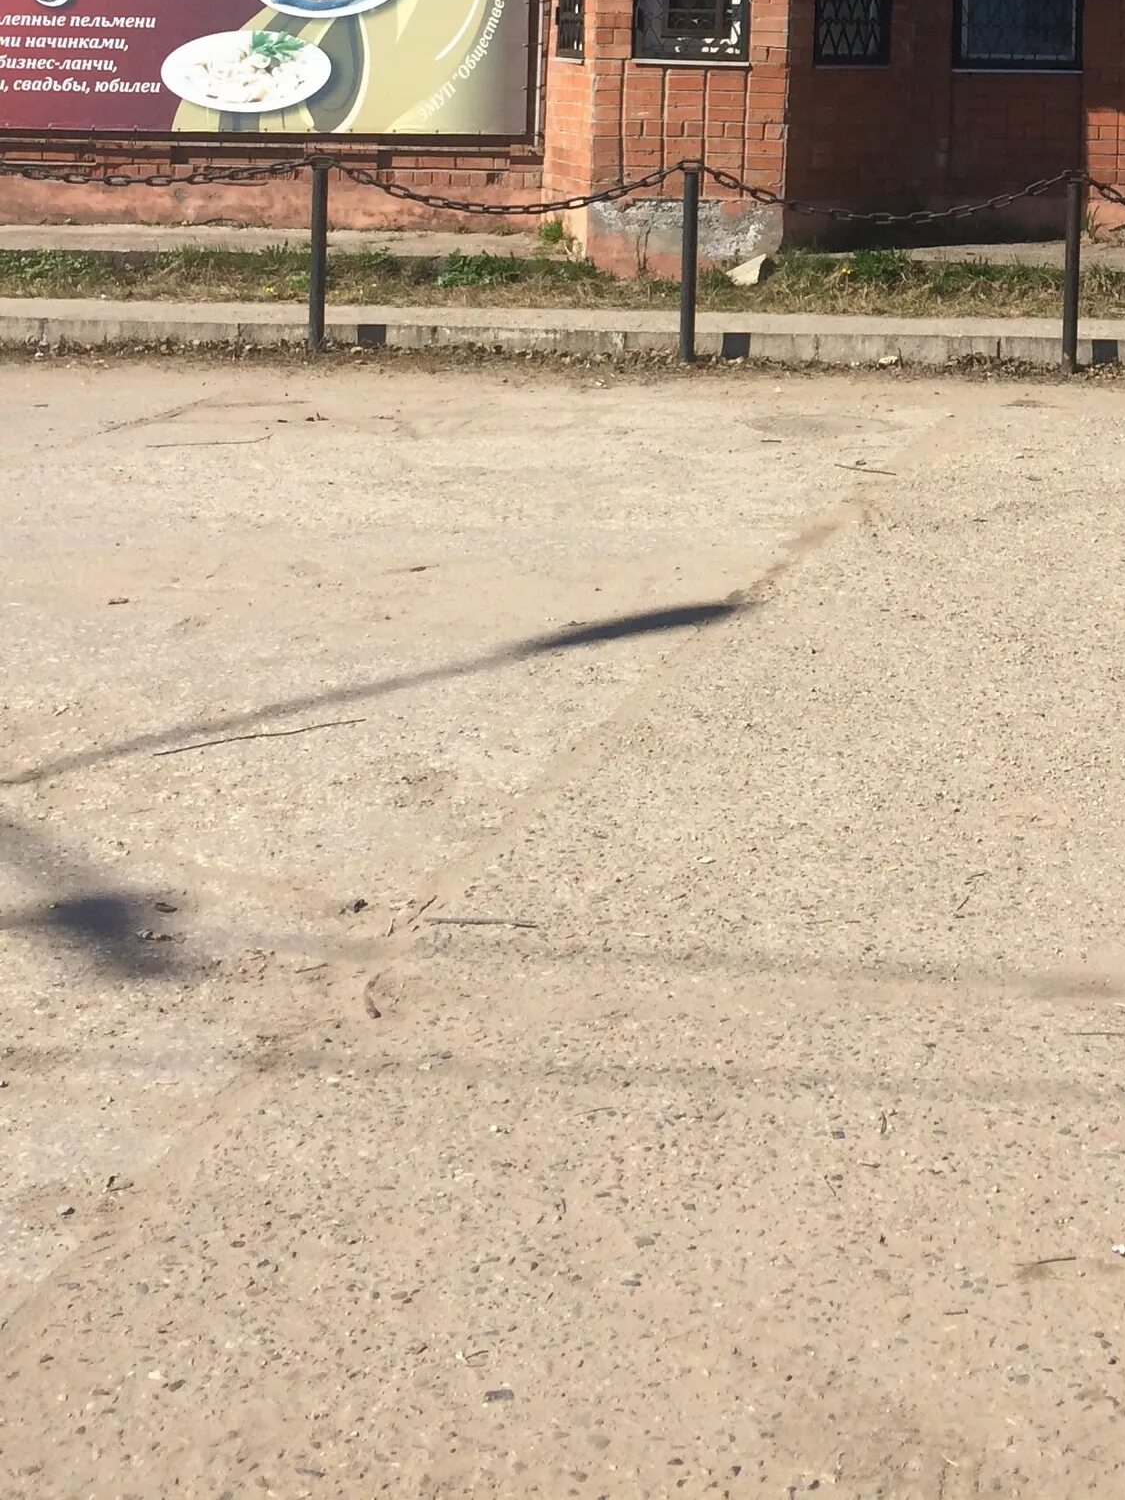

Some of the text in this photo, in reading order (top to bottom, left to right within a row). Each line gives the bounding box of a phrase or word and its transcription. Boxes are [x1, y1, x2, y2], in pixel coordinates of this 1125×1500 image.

[69, 14, 157, 29] пельмени
[25, 36, 129, 51] начинками,
[13, 76, 91, 95] свадьбы,
[94, 78, 162, 93] юбилеи
[416, 80, 457, 122] ЭМУП
